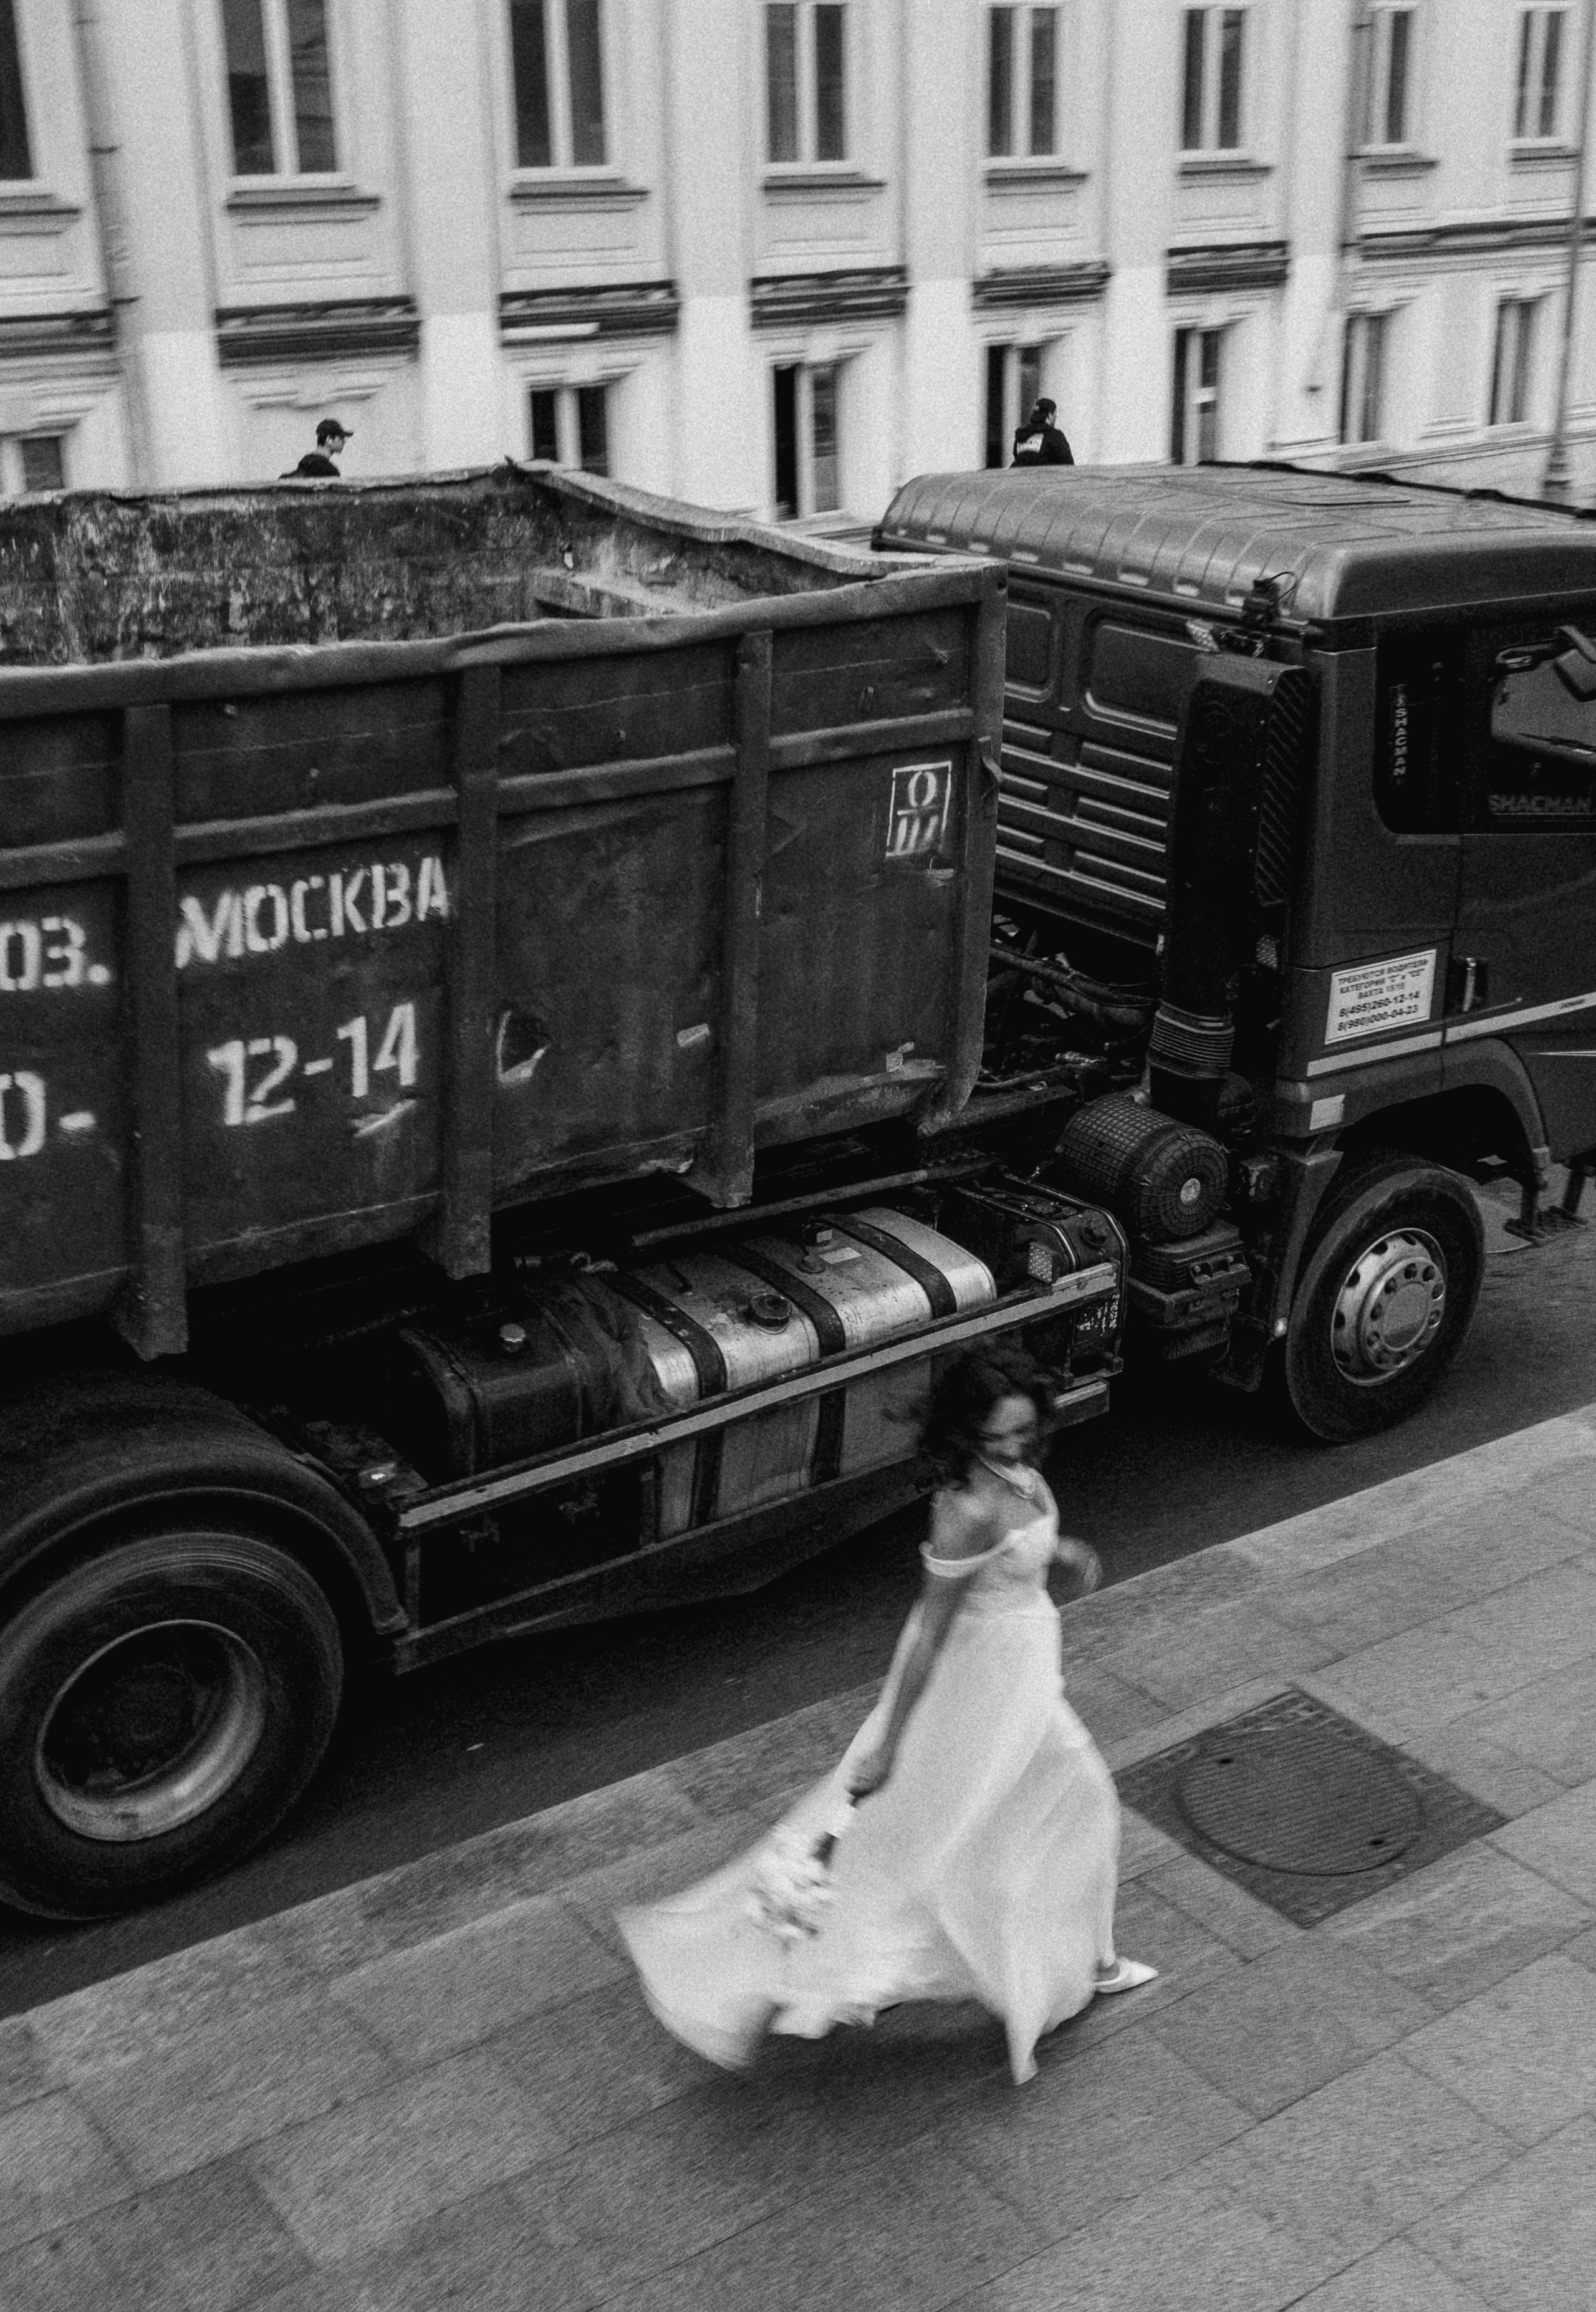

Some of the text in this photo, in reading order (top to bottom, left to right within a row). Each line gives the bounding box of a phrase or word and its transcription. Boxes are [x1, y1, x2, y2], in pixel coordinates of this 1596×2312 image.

[1393, 708, 1408, 776] SHACMAN
[1488, 794, 1591, 812] SHACMAN
[175, 856, 450, 969] МОСКВА
[206, 1003, 421, 1125] 12-14
